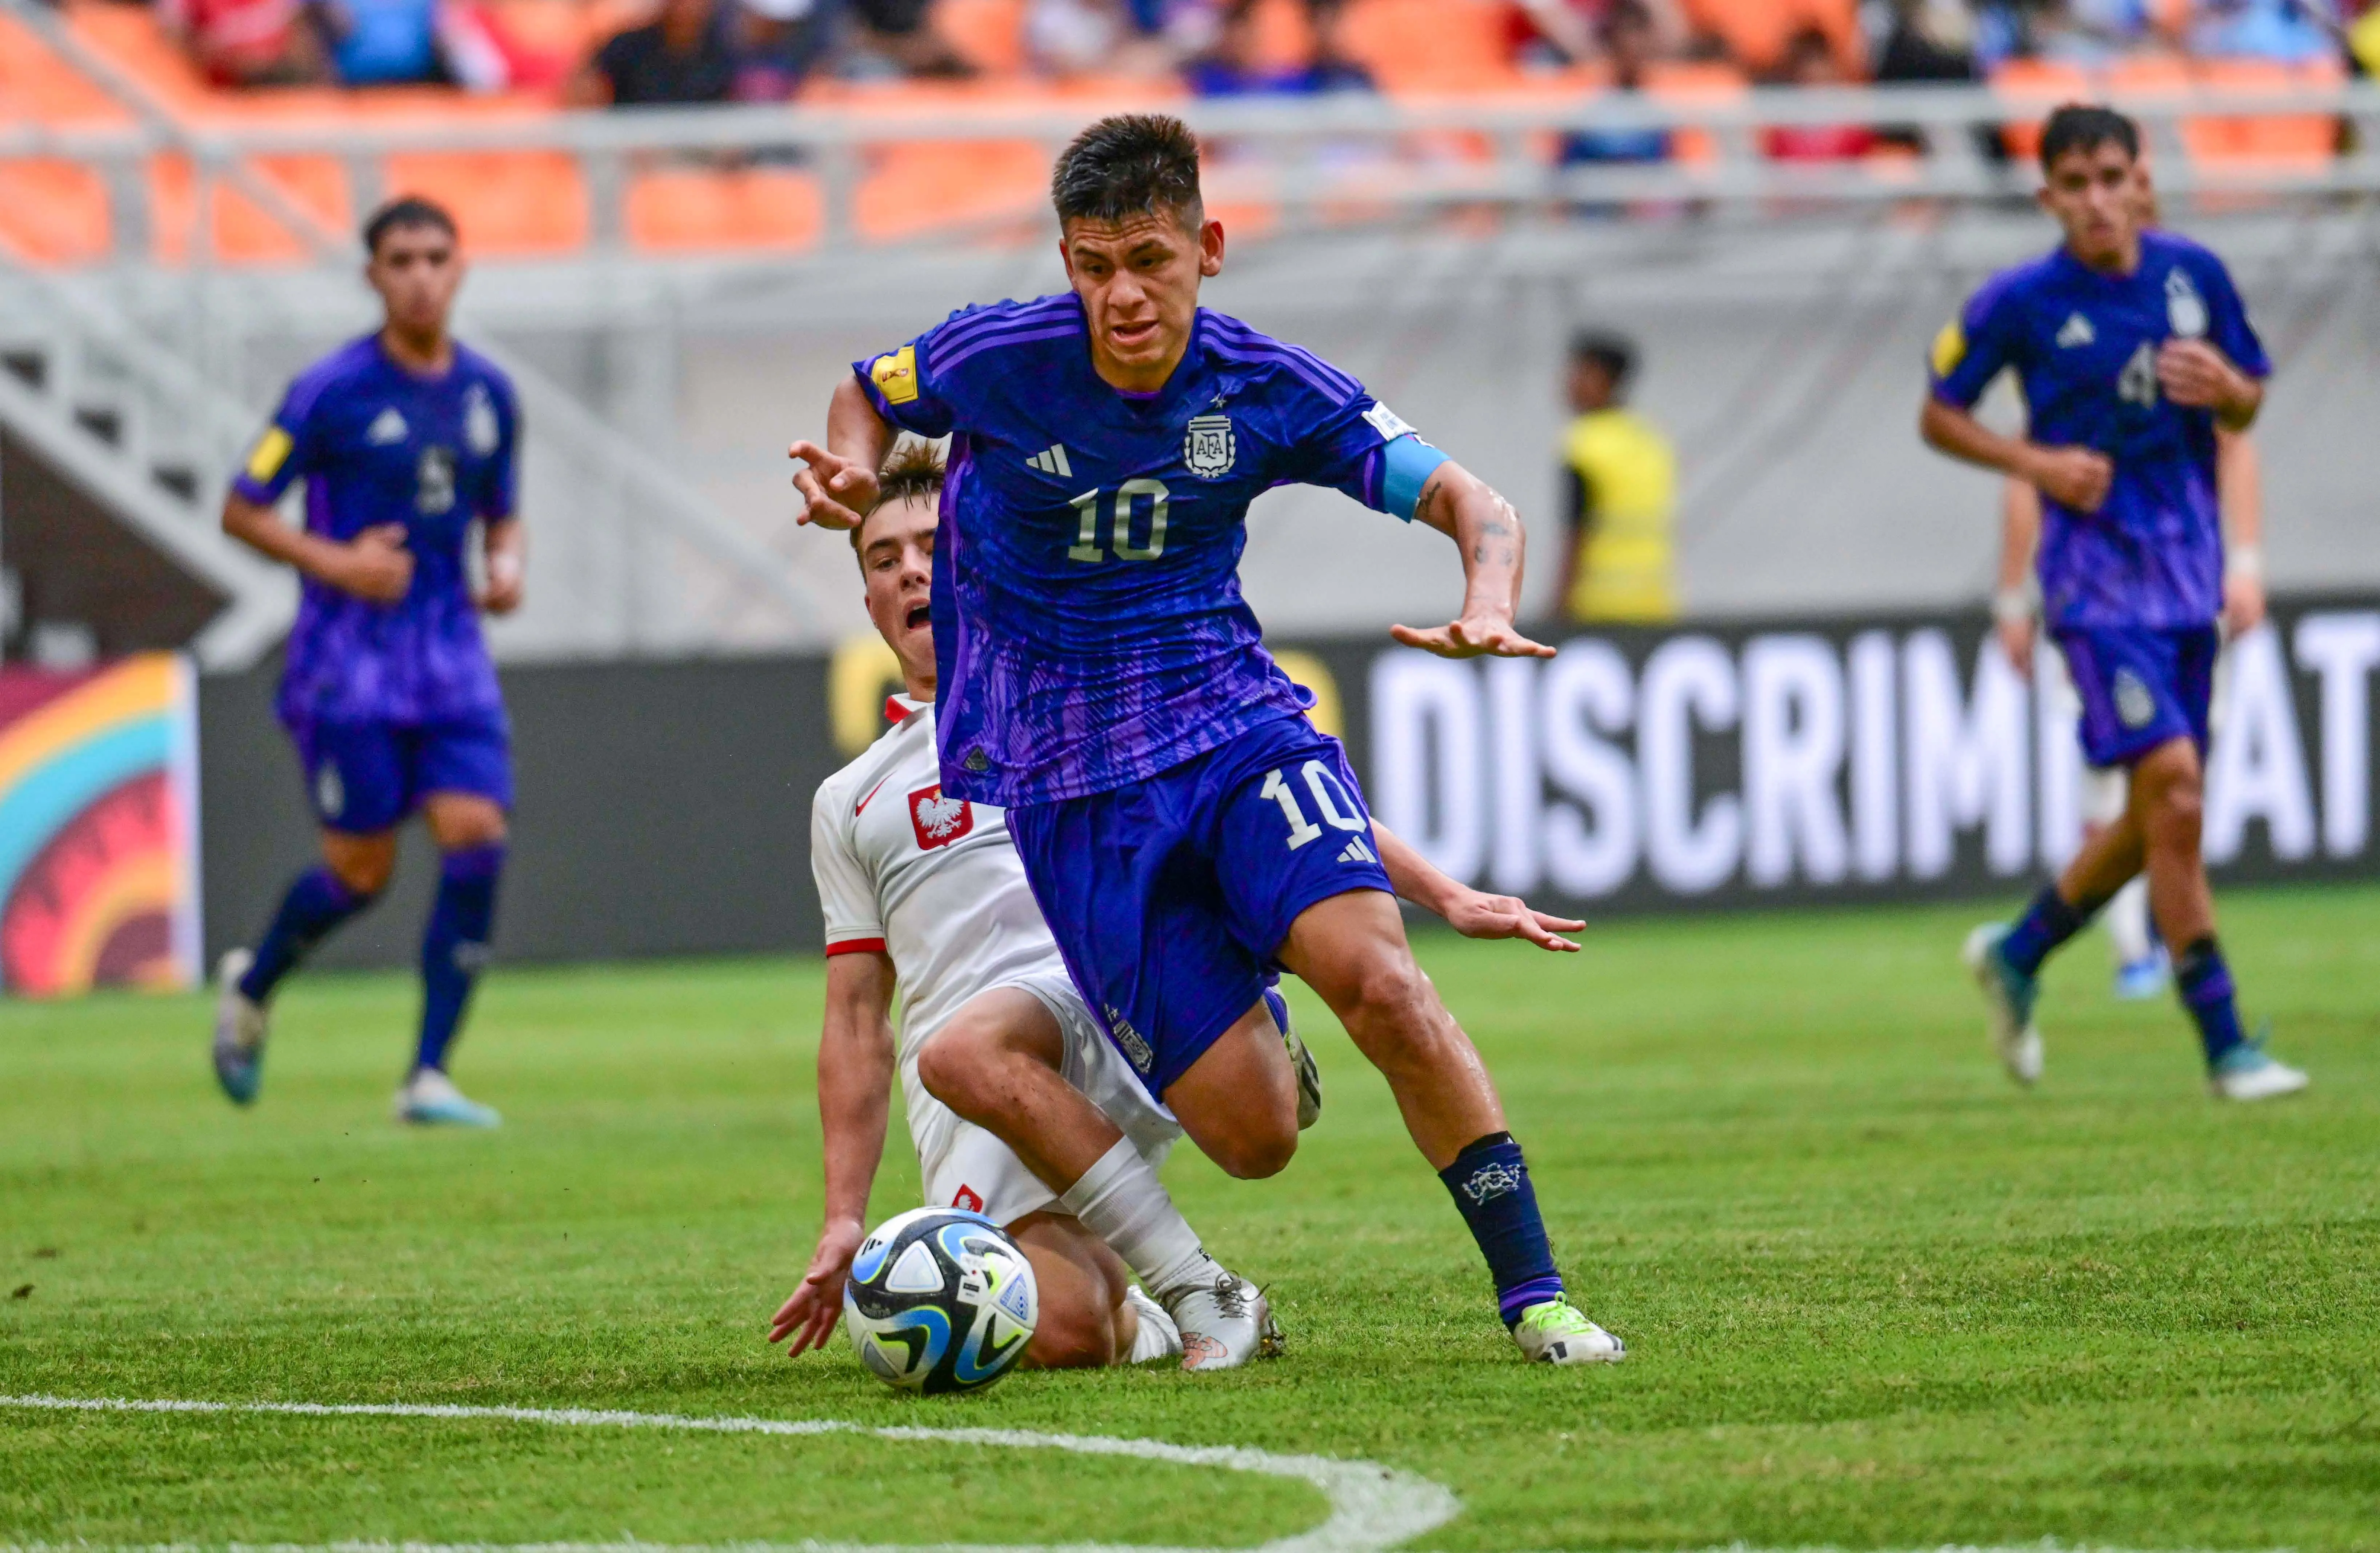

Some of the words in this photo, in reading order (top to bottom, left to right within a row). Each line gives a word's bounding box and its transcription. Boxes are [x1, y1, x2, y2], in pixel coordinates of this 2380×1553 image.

[1196, 432, 1224, 459] AFA
[1068, 479, 1170, 562] 10
[1372, 613, 2380, 897] DISCRIMIAT
[1260, 760, 1367, 851] 10
